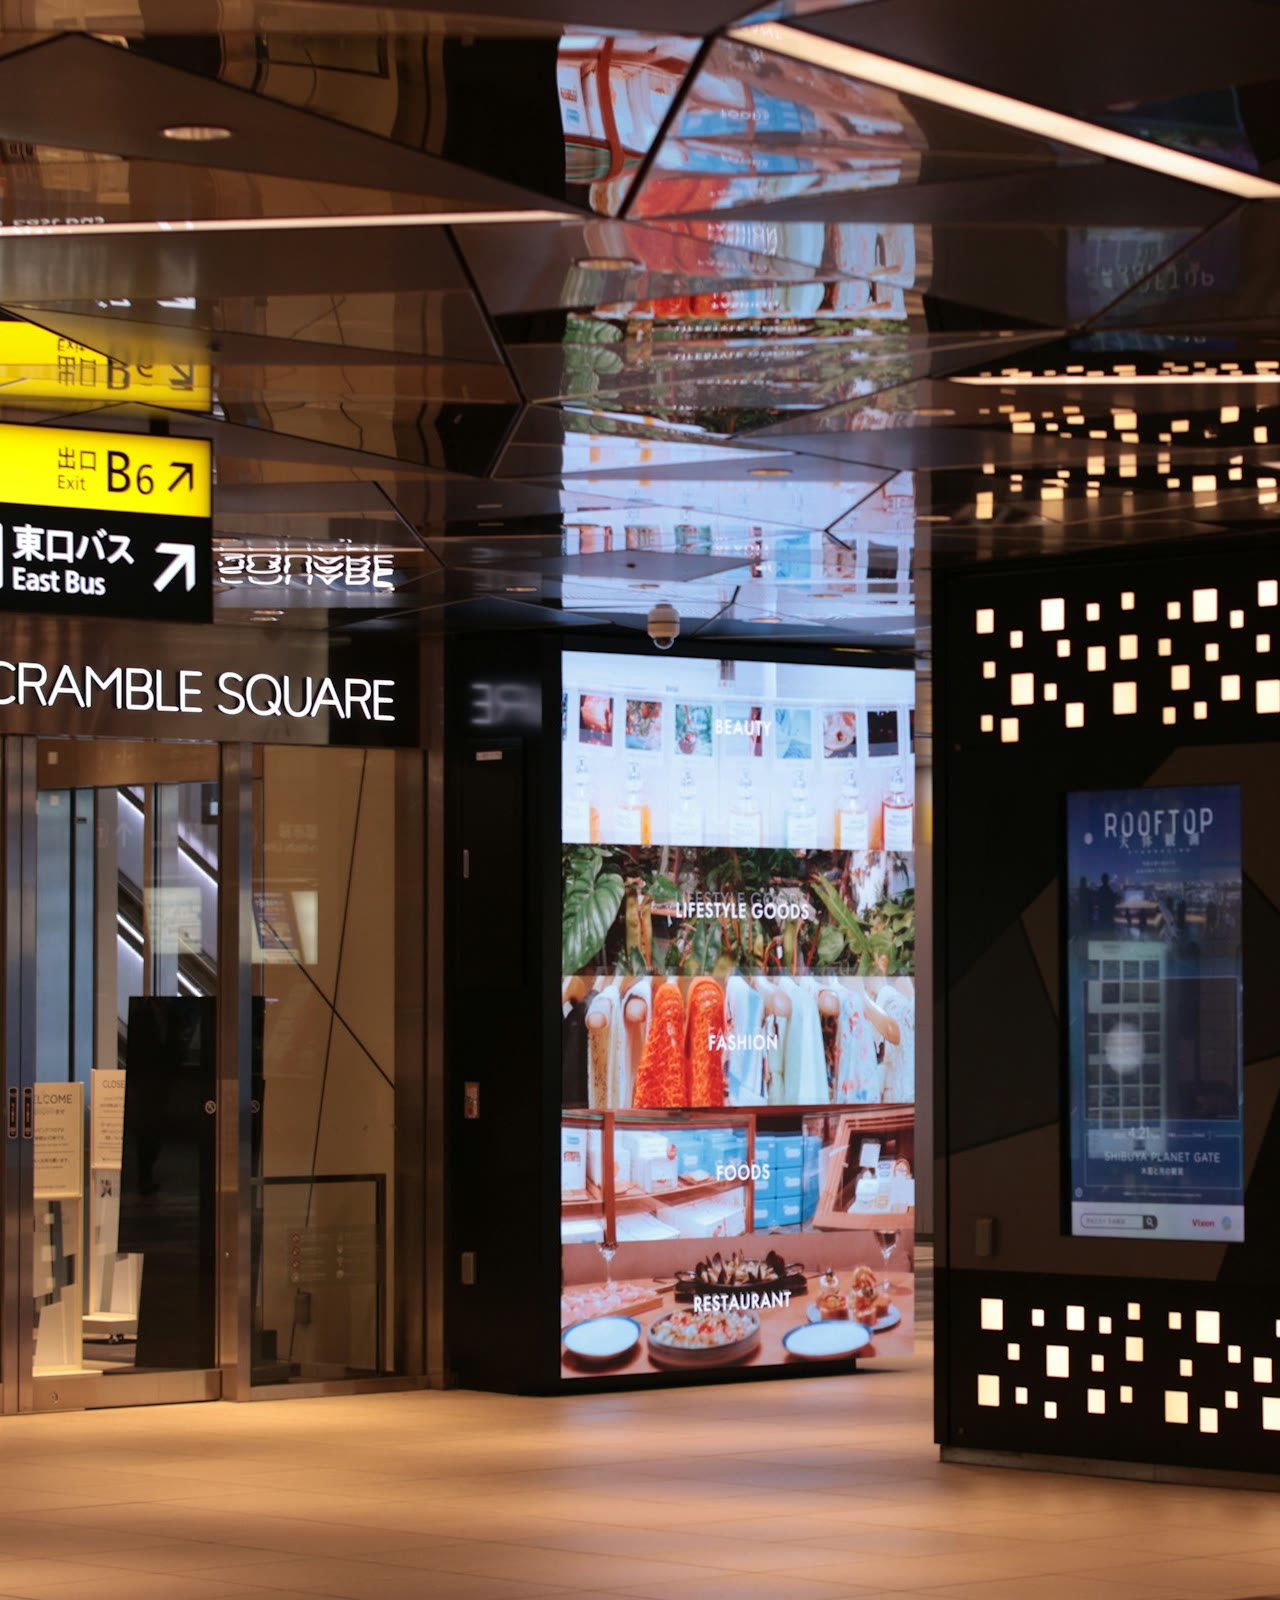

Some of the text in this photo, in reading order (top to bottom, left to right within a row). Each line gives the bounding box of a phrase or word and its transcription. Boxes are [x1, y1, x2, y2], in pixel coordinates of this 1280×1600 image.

[57, 446, 97, 472] 出口
[57, 474, 87, 491] Exit
[107, 450, 154, 495] B6
[11, 523, 135, 566] 東口バス
[11, 566, 106, 596] East Bus
[217, 671, 396, 722] SQUARE
[714, 718, 773, 737] BEAUTY
[1103, 807, 1214, 839] ROOFTOP
[675, 901, 810, 920] LIFESTYLE GOODS
[708, 1034, 778, 1052] FASHION
[34, 1094, 73, 1105] LCOME
[1104, 1151, 1221, 1163] SHIBUYA PLANET GATE
[716, 1163, 771, 1182] FOODS
[693, 1290, 792, 1312] RESTAURANT
